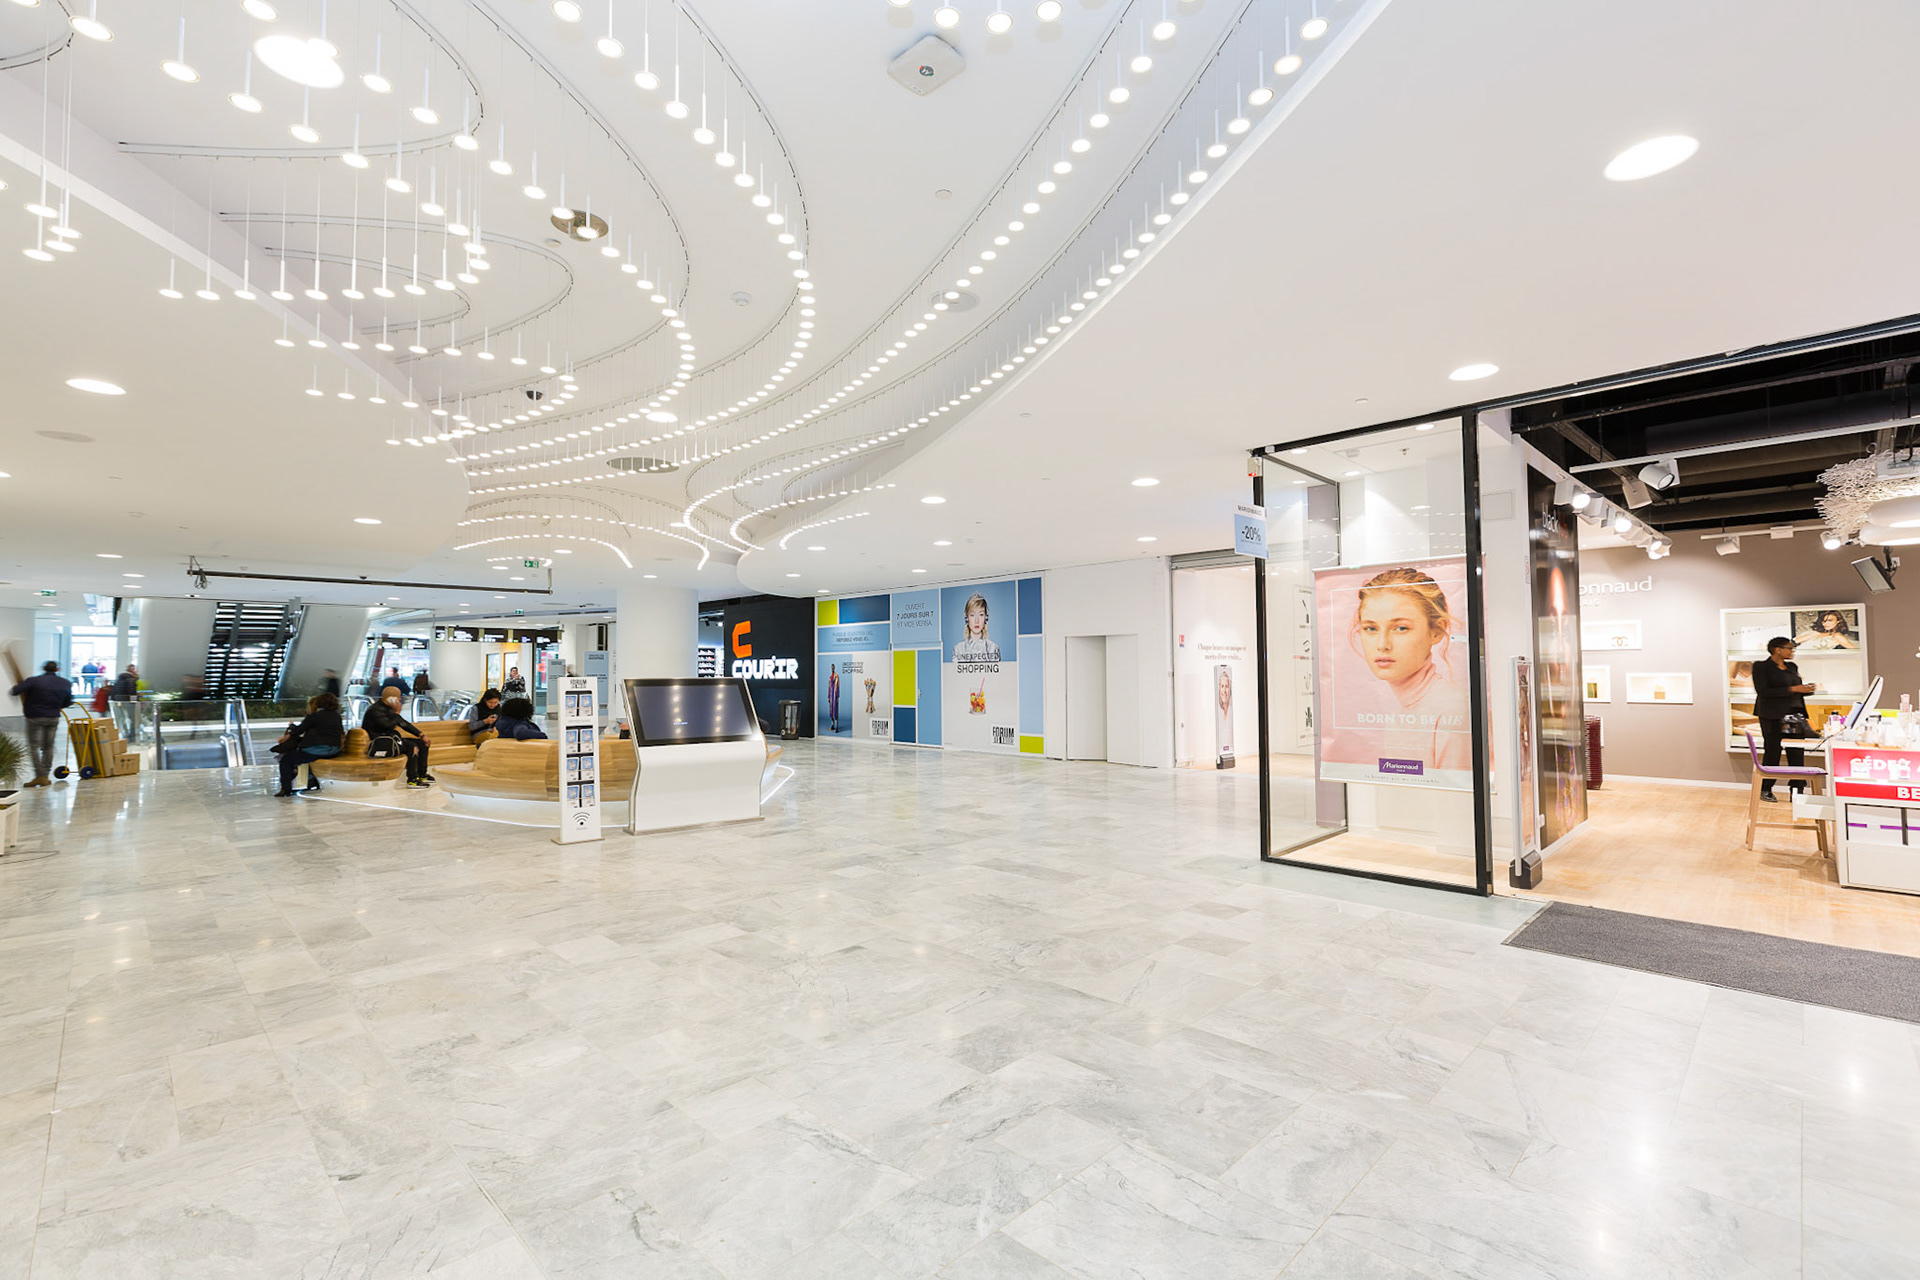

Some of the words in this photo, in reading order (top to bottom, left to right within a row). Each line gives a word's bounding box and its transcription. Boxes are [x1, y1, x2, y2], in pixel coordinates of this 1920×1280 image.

[1241, 525, 1262, 542] -20%
[732, 620, 752, 659] C
[957, 652, 1000, 660] UNEXPECTED
[732, 655, 799, 679] COURIR
[957, 664, 1000, 673] SHOPPING
[872, 720, 889, 729] FORUM
[1357, 713, 1395, 725] BORN
[1398, 714, 1417, 725] TO
[1420, 714, 1436, 725] BE
[992, 726, 1015, 738] FORUM
[1382, 761, 1419, 770] Marionnaud
